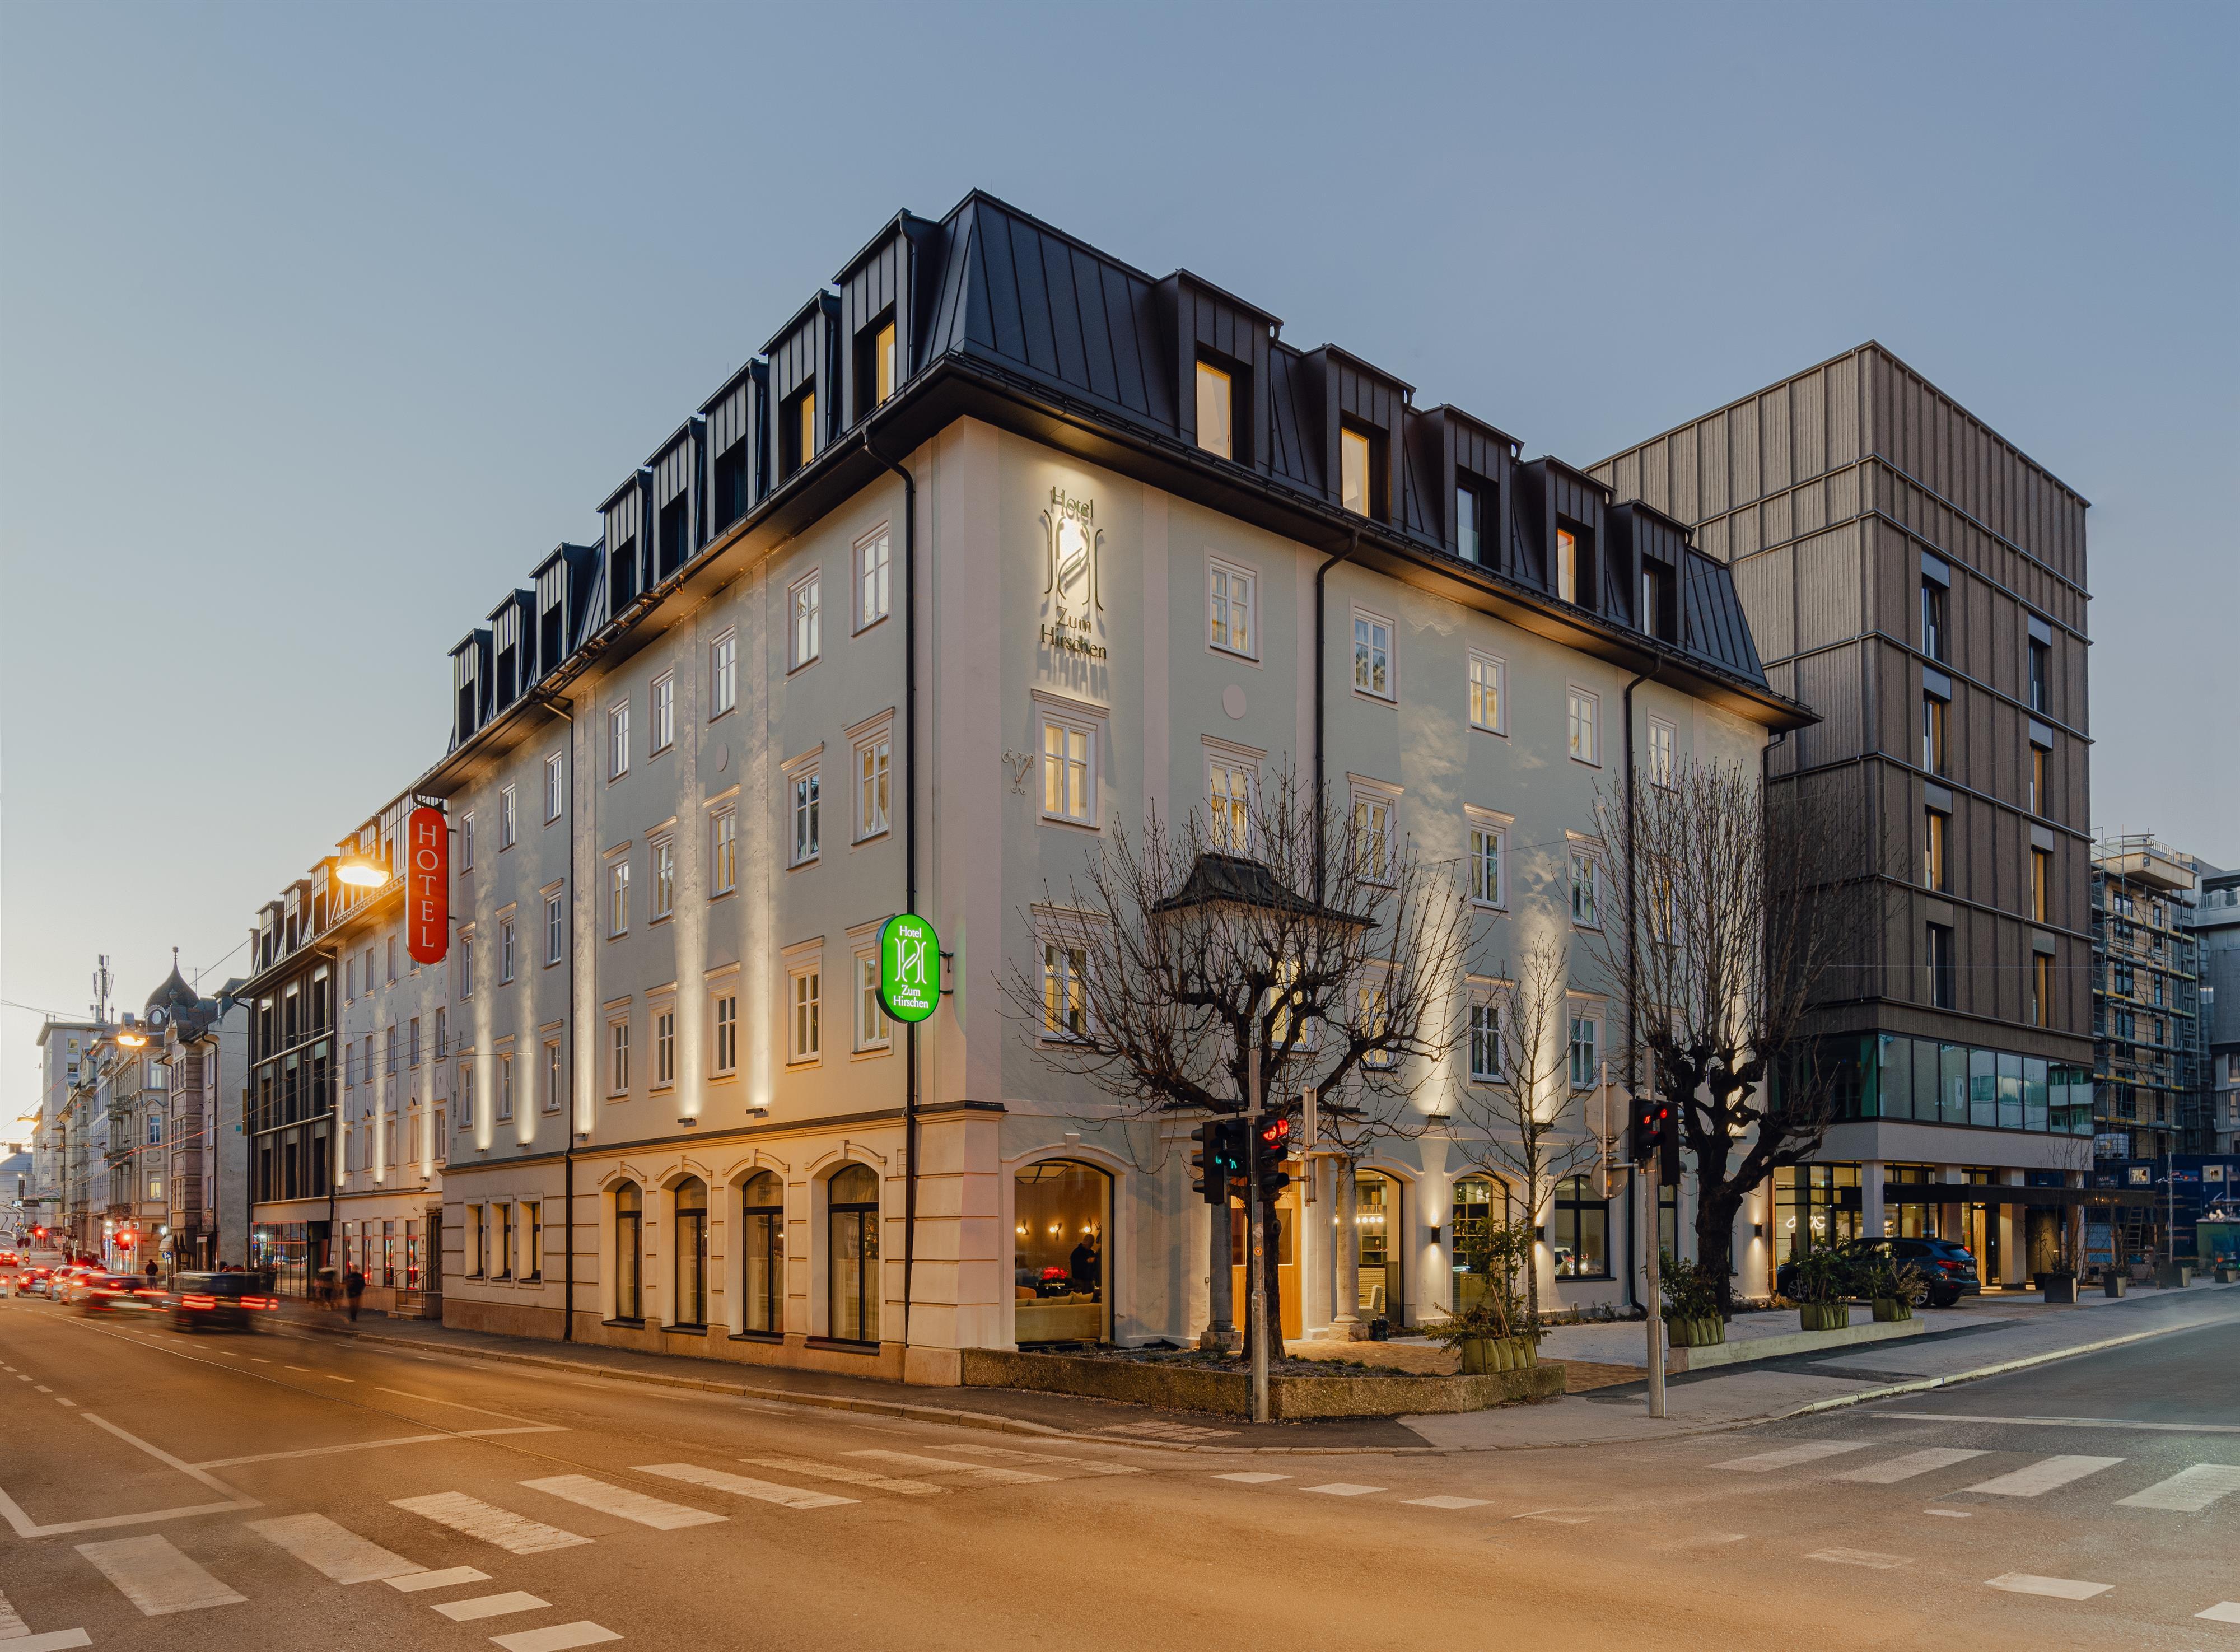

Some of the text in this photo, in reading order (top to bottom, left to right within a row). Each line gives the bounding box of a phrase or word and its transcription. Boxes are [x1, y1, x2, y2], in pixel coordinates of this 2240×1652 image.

[1053, 486, 1093, 518] Hotel
[1056, 605, 1091, 633] Zum
[1041, 623, 1107, 659] Hirschen
[417, 823, 438, 948] HOTEL
[899, 925, 921, 938] Hotel
[893, 996, 928, 1008] Hirschen
[901, 984, 921, 996] Zum
